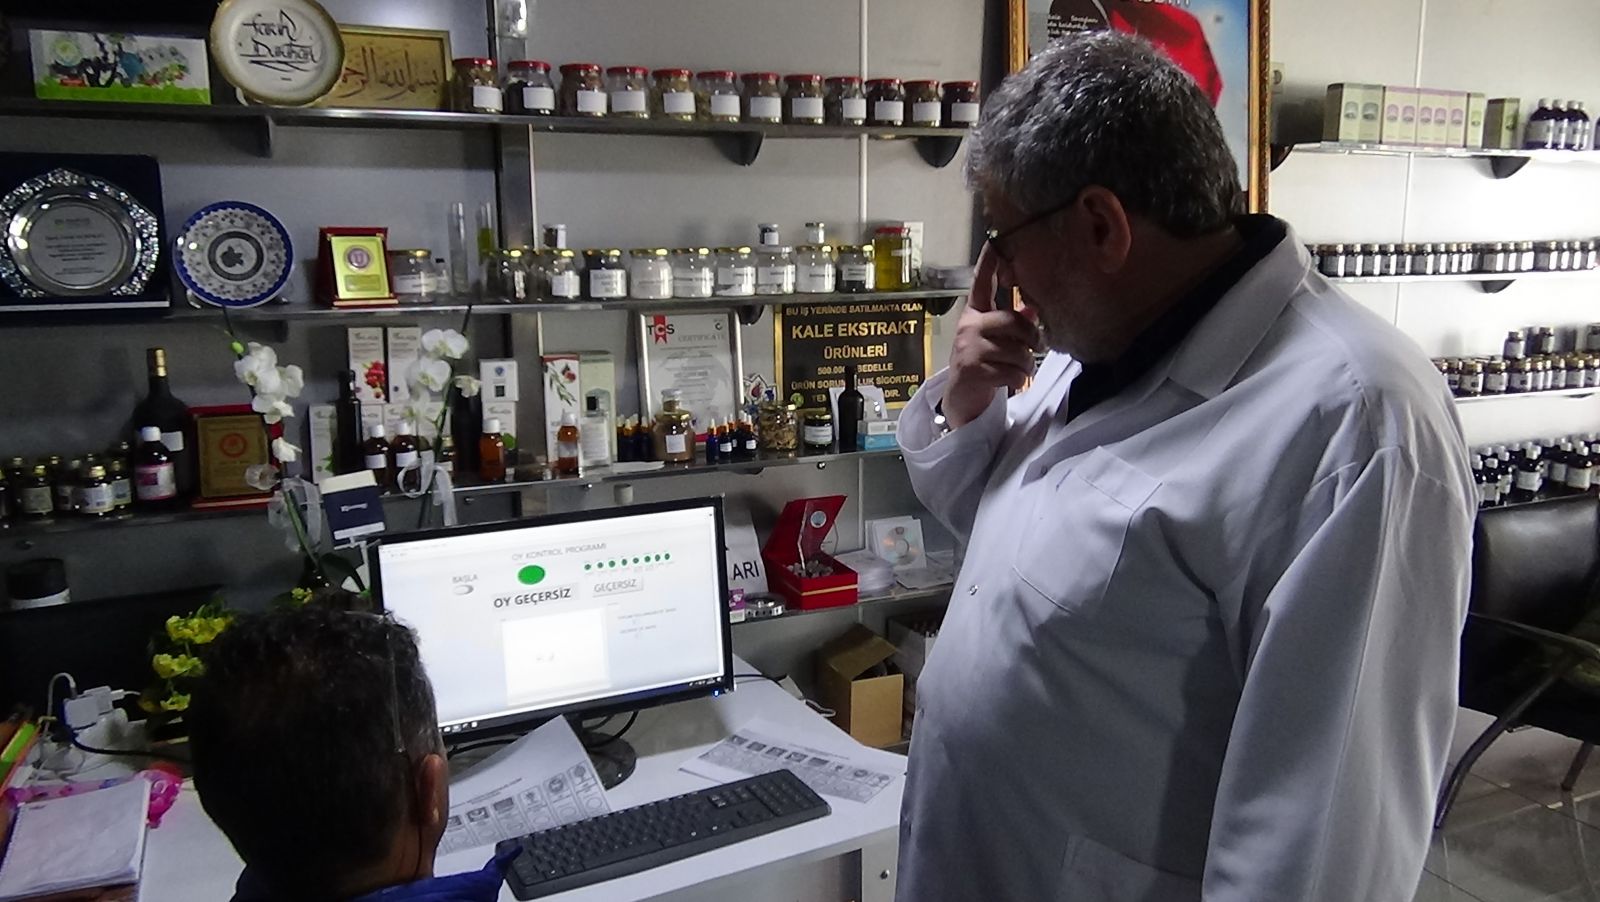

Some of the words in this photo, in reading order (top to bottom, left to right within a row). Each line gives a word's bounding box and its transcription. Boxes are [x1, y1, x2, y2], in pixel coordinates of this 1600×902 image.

[786, 307, 799, 316] BU
[810, 304, 848, 316] YERİNDE
[849, 303, 900, 314] SATILMAKTA
[901, 302, 923, 312] OLAN
[647, 323, 675, 335] TCS
[792, 323, 834, 339] KALE
[838, 320, 918, 337] EKSTRAKT
[824, 343, 888, 359] ÜRÜNLERİ
[791, 379, 816, 390] ÜRÜN
[876, 374, 919, 385] SİGORTASI
[526, 548, 563, 559] KONTROL
[565, 543, 607, 553] PROGRAMI
[593, 578, 637, 593] GEÇERSİZ
[494, 597, 511, 609] OY
[514, 587, 572, 606] GEÇERSİZ
